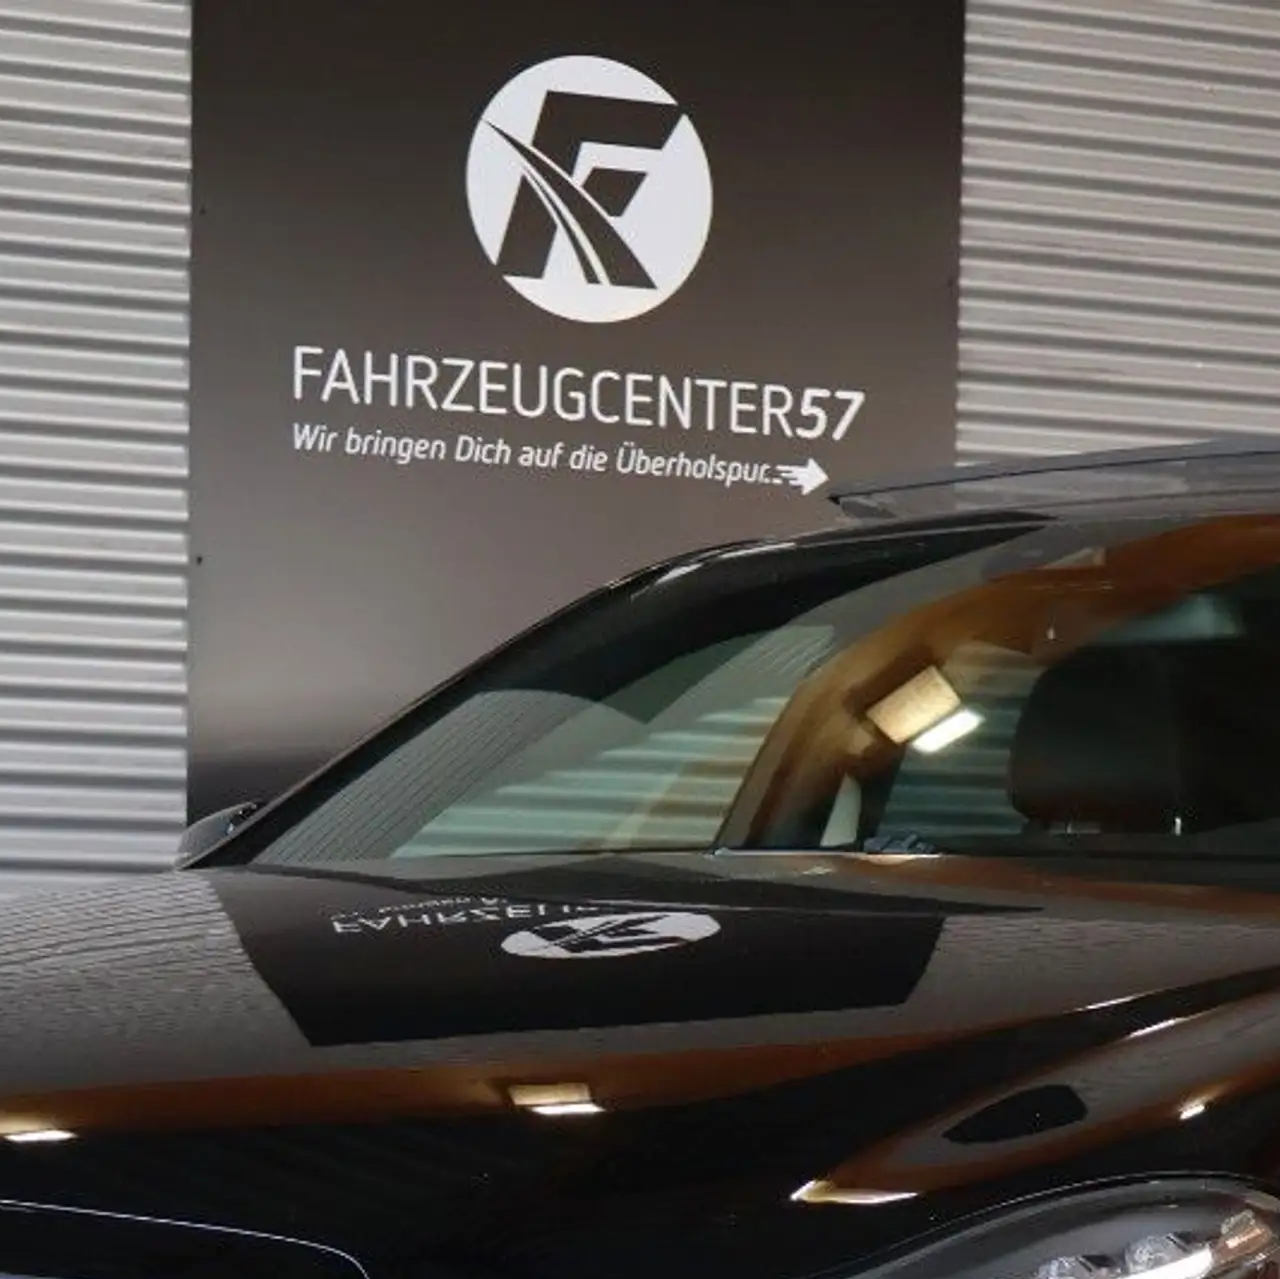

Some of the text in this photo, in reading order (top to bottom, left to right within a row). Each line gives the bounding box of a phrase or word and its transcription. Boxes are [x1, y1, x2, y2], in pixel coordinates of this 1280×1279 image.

[293, 346, 865, 441] FAHRZEUGCENTER57
[293, 422, 337, 452] Wir
[345, 426, 446, 464] bringen
[455, 435, 511, 464] Dich
[518, 442, 564, 469] auf
[569, 445, 608, 471] die
